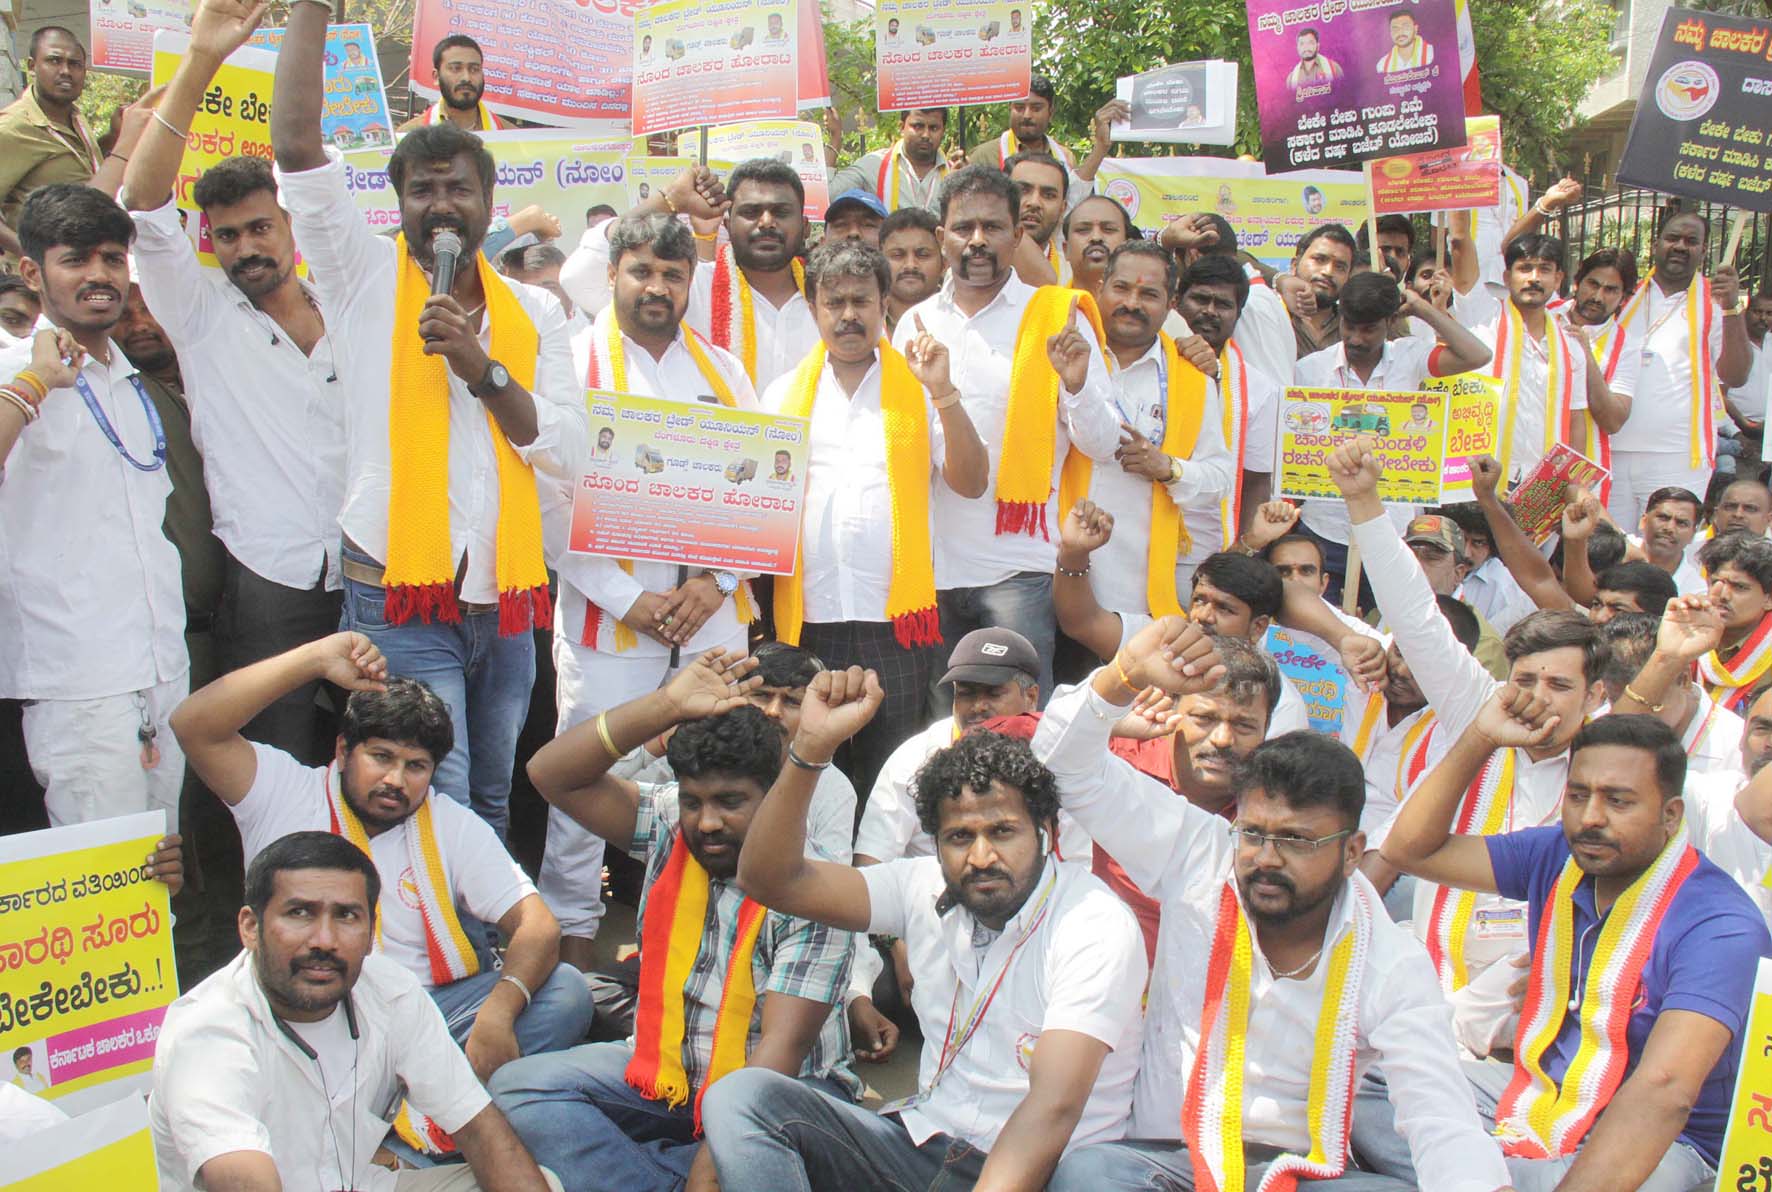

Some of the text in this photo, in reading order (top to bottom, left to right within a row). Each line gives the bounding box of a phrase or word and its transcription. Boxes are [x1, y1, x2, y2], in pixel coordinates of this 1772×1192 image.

[1258, 13, 1283, 34] ನಮ್ಮ
[1284, 8, 1319, 25] ಚಾಲಕರ
[1321, 1, 1348, 22] ಟ್ರೇಡ್
[1674, 18, 1708, 52] ನಮ್ಮ
[1710, 26, 1768, 54] ಚಾಲಕರ
[638, 52, 792, 86] ನೊಂದ ಚಾಲಕರ ಹೋರಾಟ
[882, 44, 1027, 64] ನೊಂದ ಚಾಲಕರ ಹೋರಾಟ
[1298, 96, 1423, 131] ಬೇಕೇ ಬೇಕು ಗುಂಪು ವಿಮೆ
[186, 128, 234, 156] ಲಕರ
[1287, 112, 1438, 149] ಸರ್ಕಾರ ಮಾಡಿಸಿ ಕೂಡಲೇಬೇಕು
[1290, 127, 1439, 166] (ಕಳೆದ ವರ್ಷ ಬಜೆಟ್ ಯೋಜನೆ)
[1699, 118, 1764, 144] ಬೇಕೇ ಬೇಕು
[1680, 138, 1760, 168] ಸರ್ಕಾರ ಮಾಡಿಸಿ
[557, 160, 624, 188] (ನೋಂ
[1674, 160, 1708, 182] (ಕಳೆದ
[1709, 169, 1736, 188] ವರ್ಷ
[592, 405, 802, 444] ನಮ್ಮ ಚಾಲಕರ ಟ್ರೇಡ್ ಯೂನಿಯನ್ (ನೋಂ)
[1452, 402, 1494, 426] ಅಭಿವೃದ್ಧಿ
[1294, 432, 1357, 447] ಚಾಲಕ
[1450, 426, 1492, 453] ಬೇಕು
[584, 472, 640, 493] ನೊಂದ
[649, 483, 714, 502] ಚಾಲಕರ
[724, 488, 795, 512] ಹೋರಾಟ
[1273, 650, 1327, 670] ಬೇಕೇ
[0, 863, 154, 914] ರ್ಕಾರದ ವತಿಯಿಂದ
[0, 901, 160, 974] ಾರಥಿ ಸೂರು
[50, 1038, 95, 1069] ಕರ್ನಾಟಕ
[96, 1028, 136, 1054] ಚಾಲಕರ
